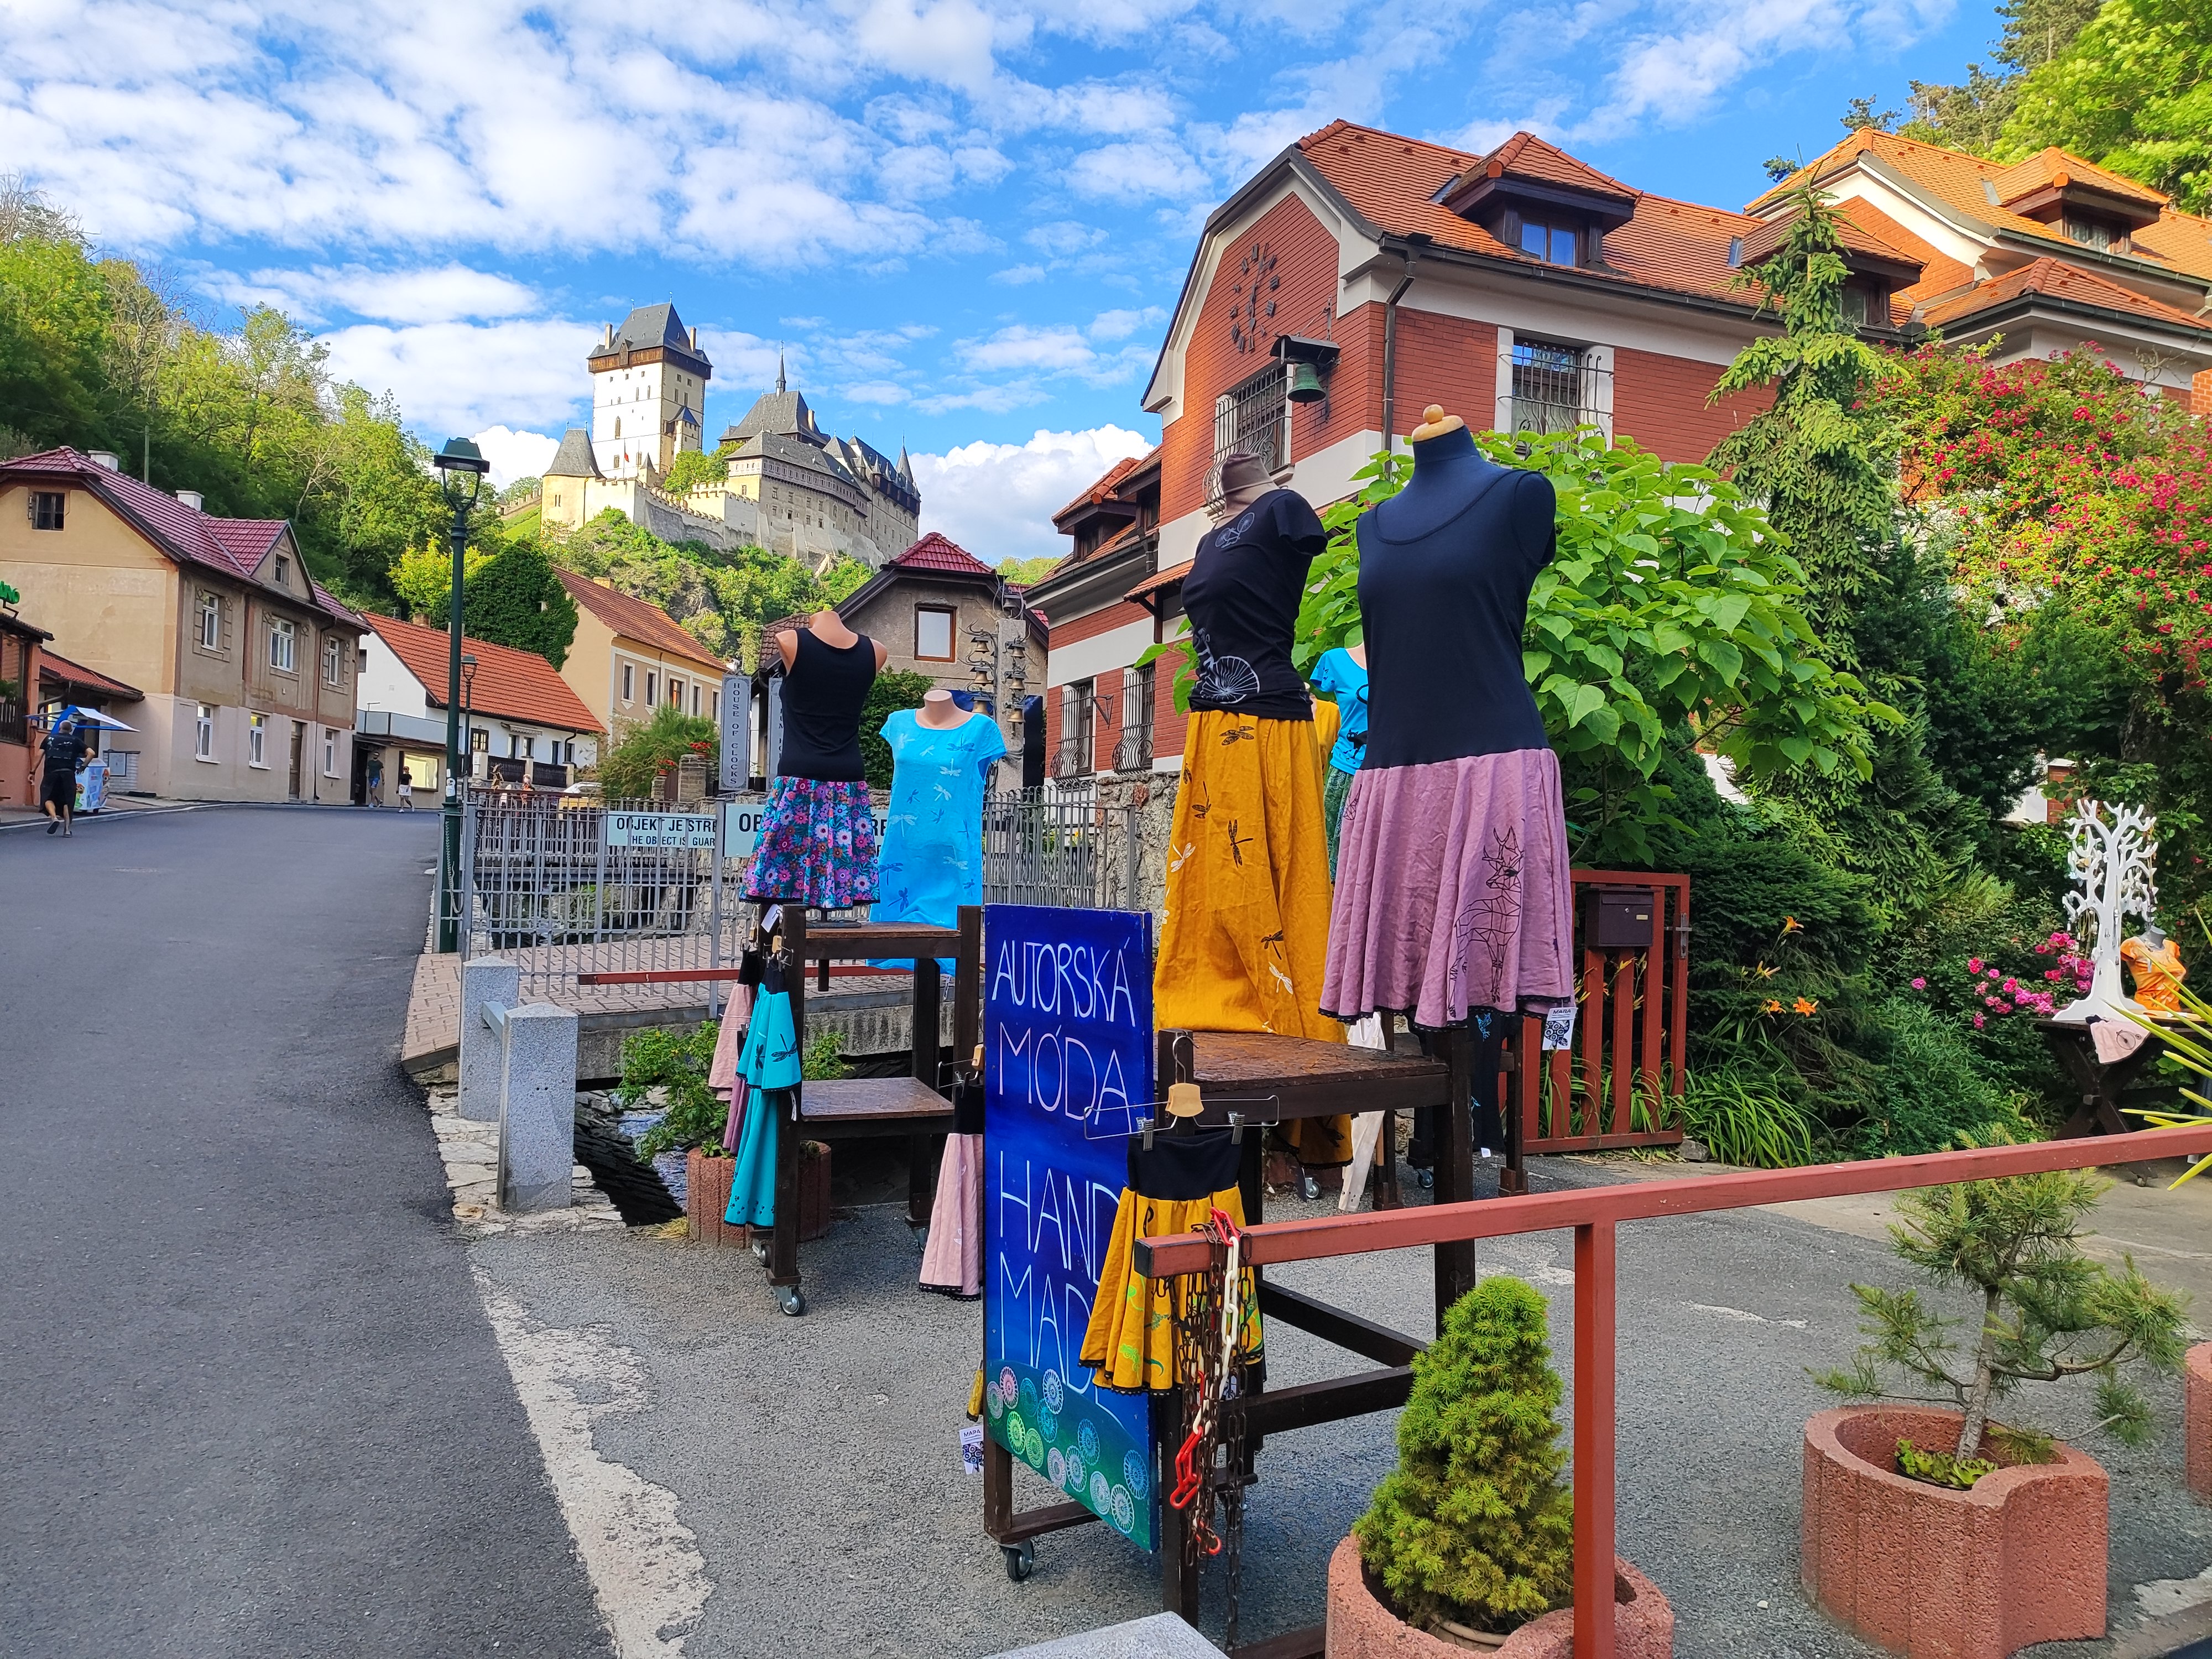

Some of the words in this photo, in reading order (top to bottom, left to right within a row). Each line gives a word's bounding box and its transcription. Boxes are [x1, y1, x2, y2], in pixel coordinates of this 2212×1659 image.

[732, 723, 739, 736] OF
[730, 743, 738, 784] CLOCKS
[646, 836, 677, 845] OBECT
[669, 820, 682, 831] JE
[992, 936, 1136, 1028] AUTORSKÁ
[999, 1021, 1132, 1135] MÓDA
[1000, 1150, 1119, 1286] HAND
[1000, 1251, 1123, 1425] MAD
